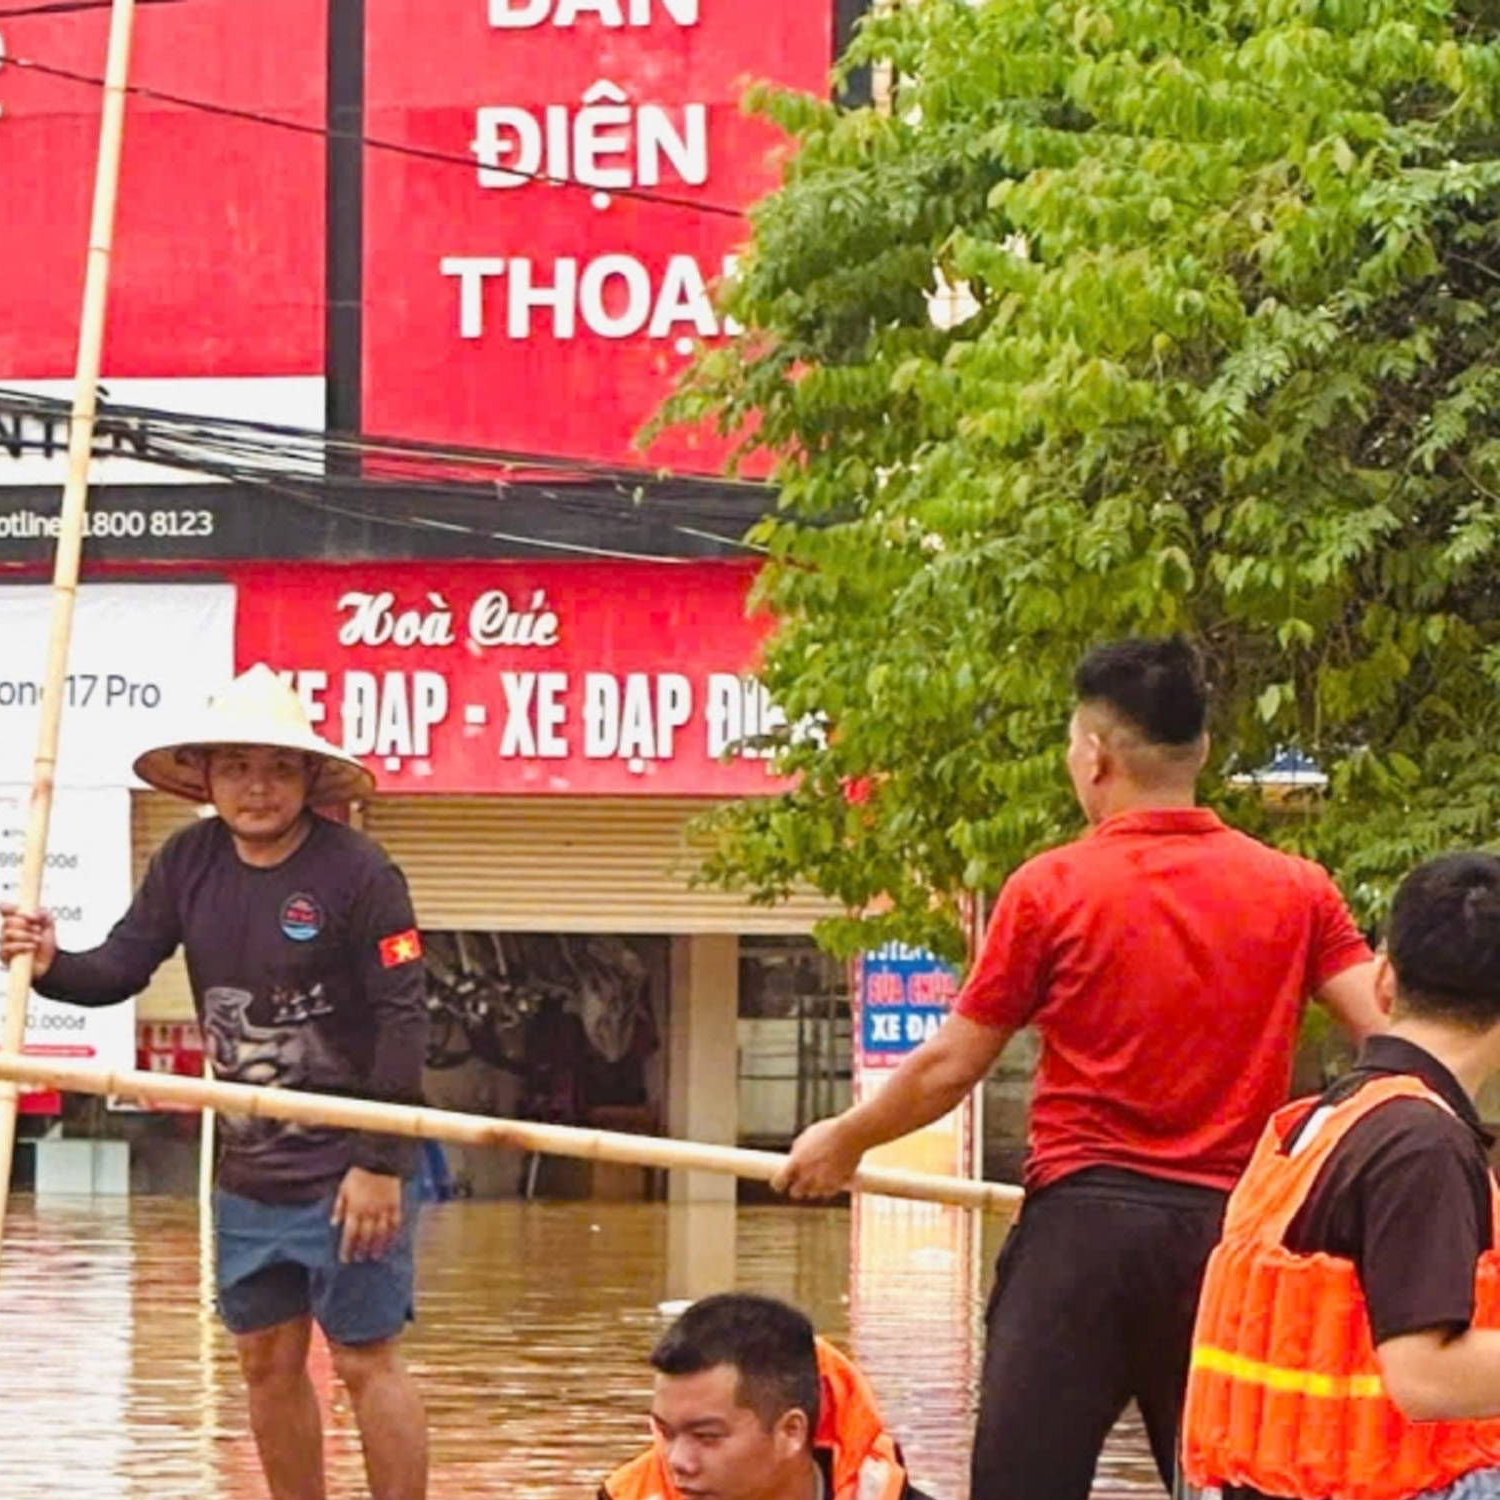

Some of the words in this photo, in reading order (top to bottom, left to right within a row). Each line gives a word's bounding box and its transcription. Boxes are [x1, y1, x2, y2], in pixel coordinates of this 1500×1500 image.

[470, 78, 709, 210] ĐIỆN
[150, 510, 214, 537] 8123
[337, 591, 455, 647] Hoà
[469, 590, 560, 647] Cúc
[64, 674, 98, 707] 17
[106, 675, 162, 707] Pro
[341, 669, 449, 772] ĐẠP
[499, 672, 568, 757] XE
[582, 673, 692, 773] ĐẠP
[871, 1013, 901, 1041] XE
